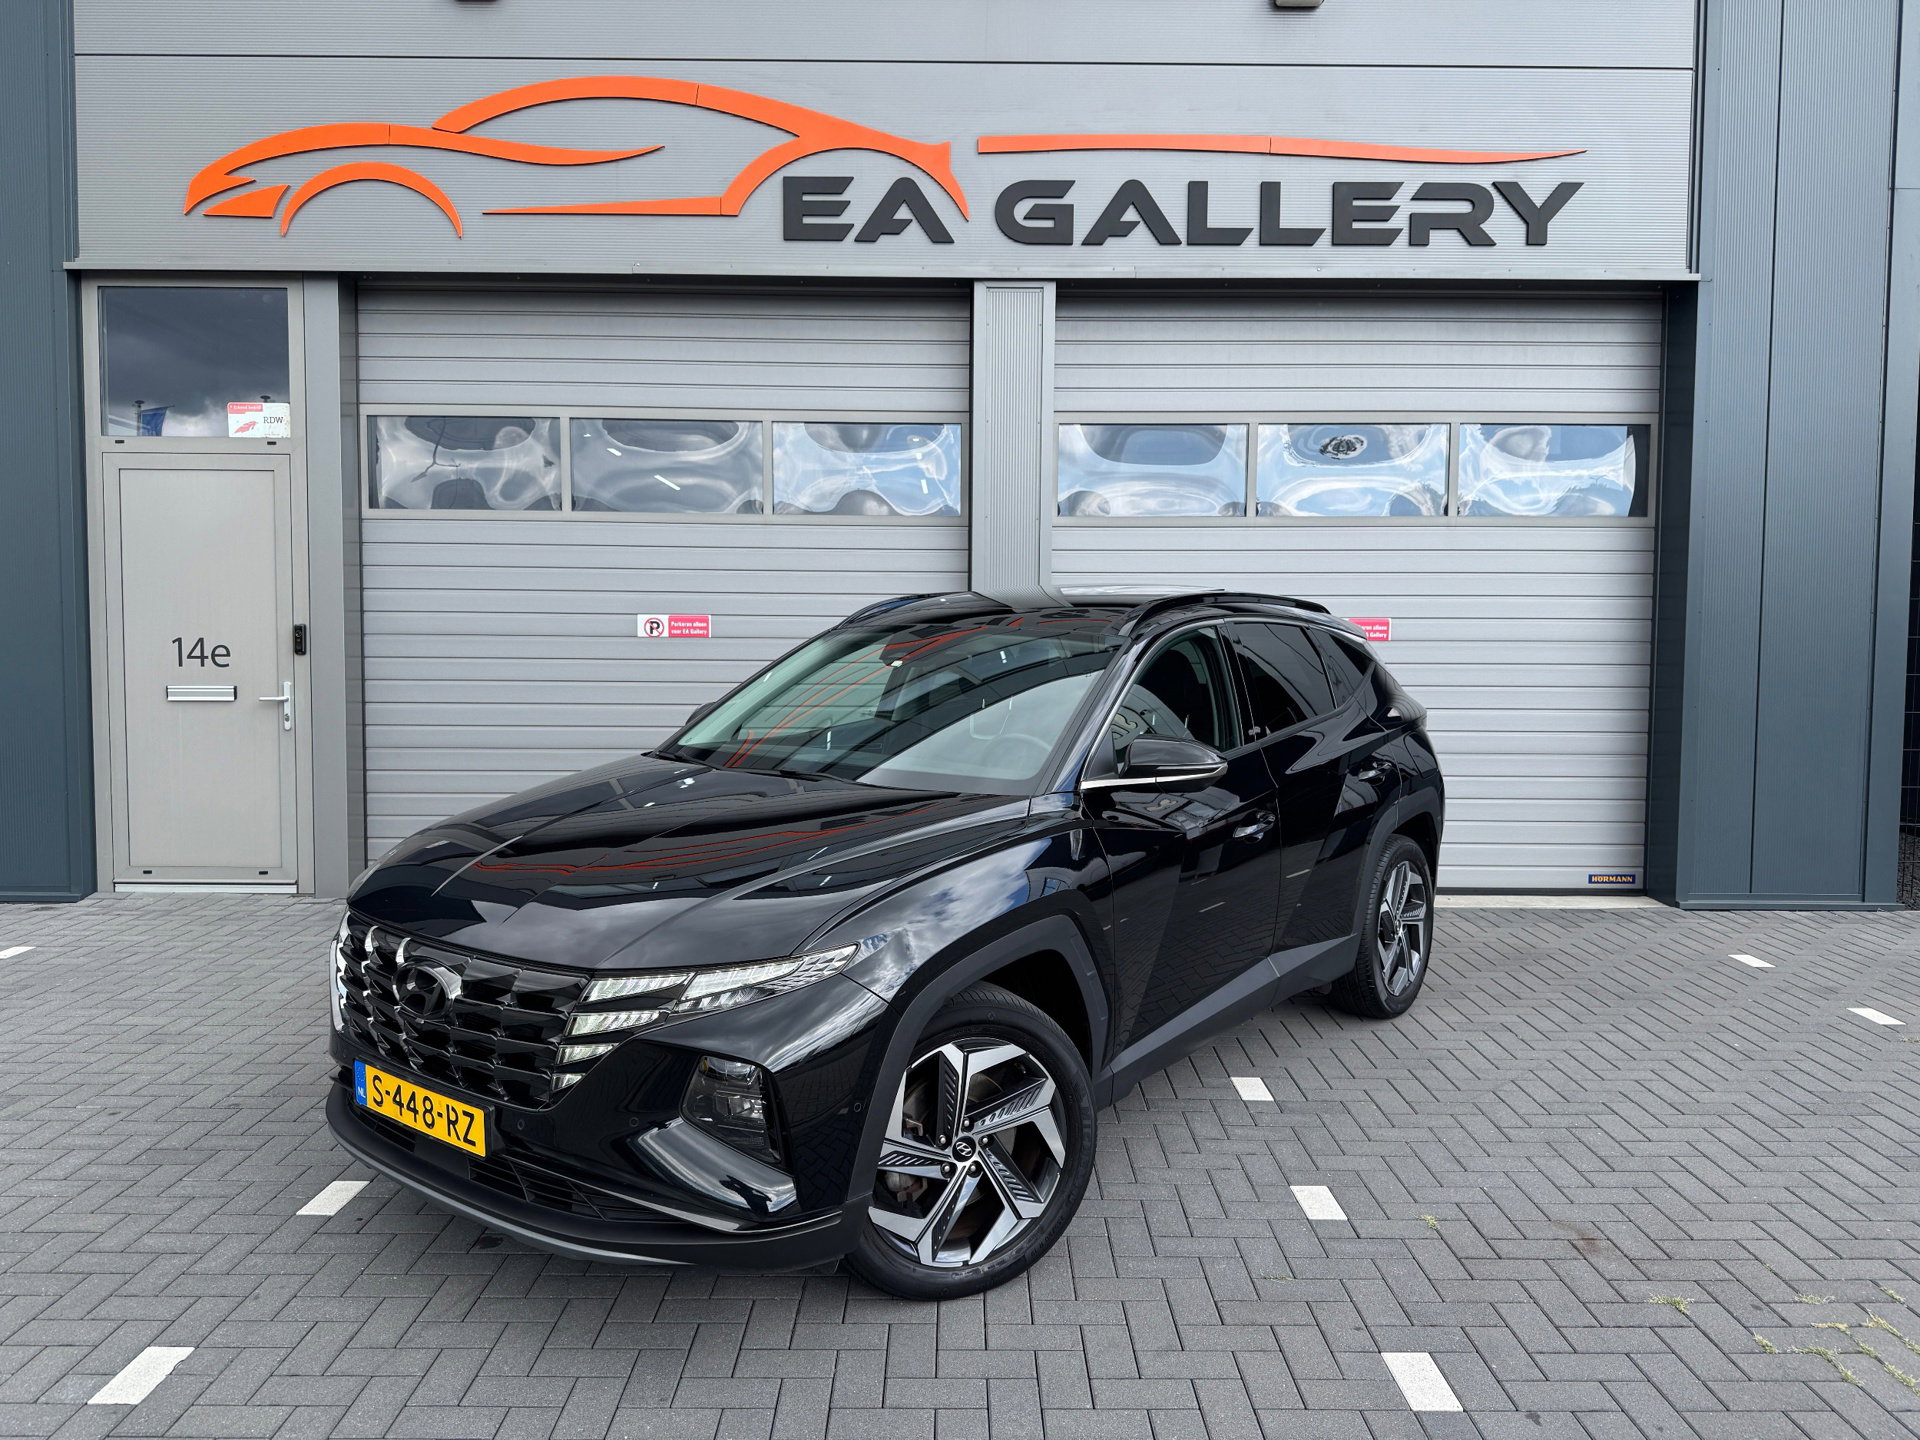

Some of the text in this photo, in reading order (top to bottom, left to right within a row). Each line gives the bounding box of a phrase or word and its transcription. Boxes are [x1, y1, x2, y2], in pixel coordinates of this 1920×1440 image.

[782, 175, 1585, 247] EA GALLERY
[263, 416, 284, 424] RDW
[172, 637, 231, 668] 14e
[357, 1074, 477, 1147] NL S-448-RZ
